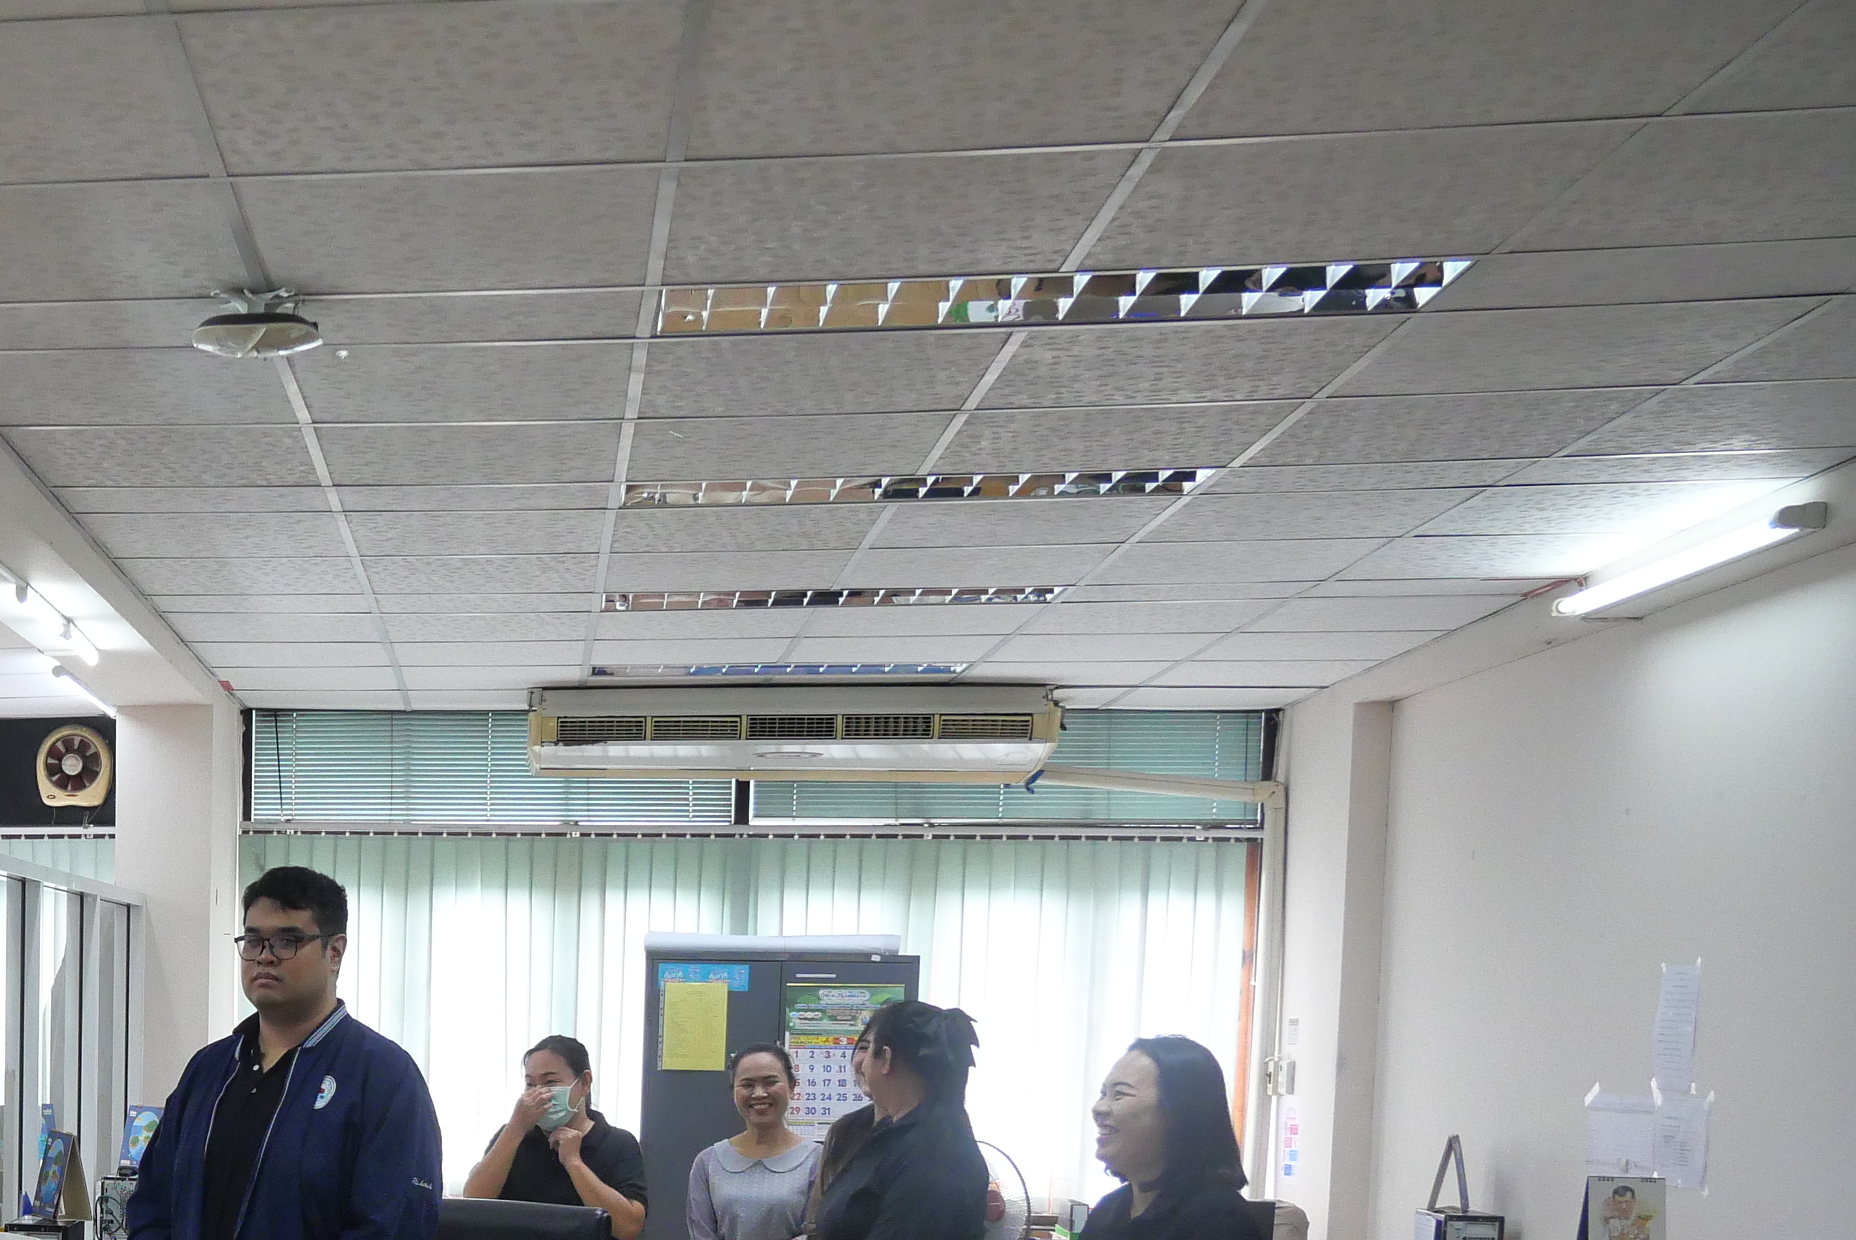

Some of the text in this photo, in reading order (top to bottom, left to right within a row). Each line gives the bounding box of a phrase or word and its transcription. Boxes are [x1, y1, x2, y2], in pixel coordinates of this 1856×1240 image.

[794, 1050, 799, 1058] 1
[838, 1065, 846, 1073] 11
[822, 1079, 831, 1087] 17
[837, 1079, 847, 1087] 18
[836, 1093, 847, 1101] 25
[852, 1093, 863, 1101] 26
[821, 1107, 830, 1115] 31
